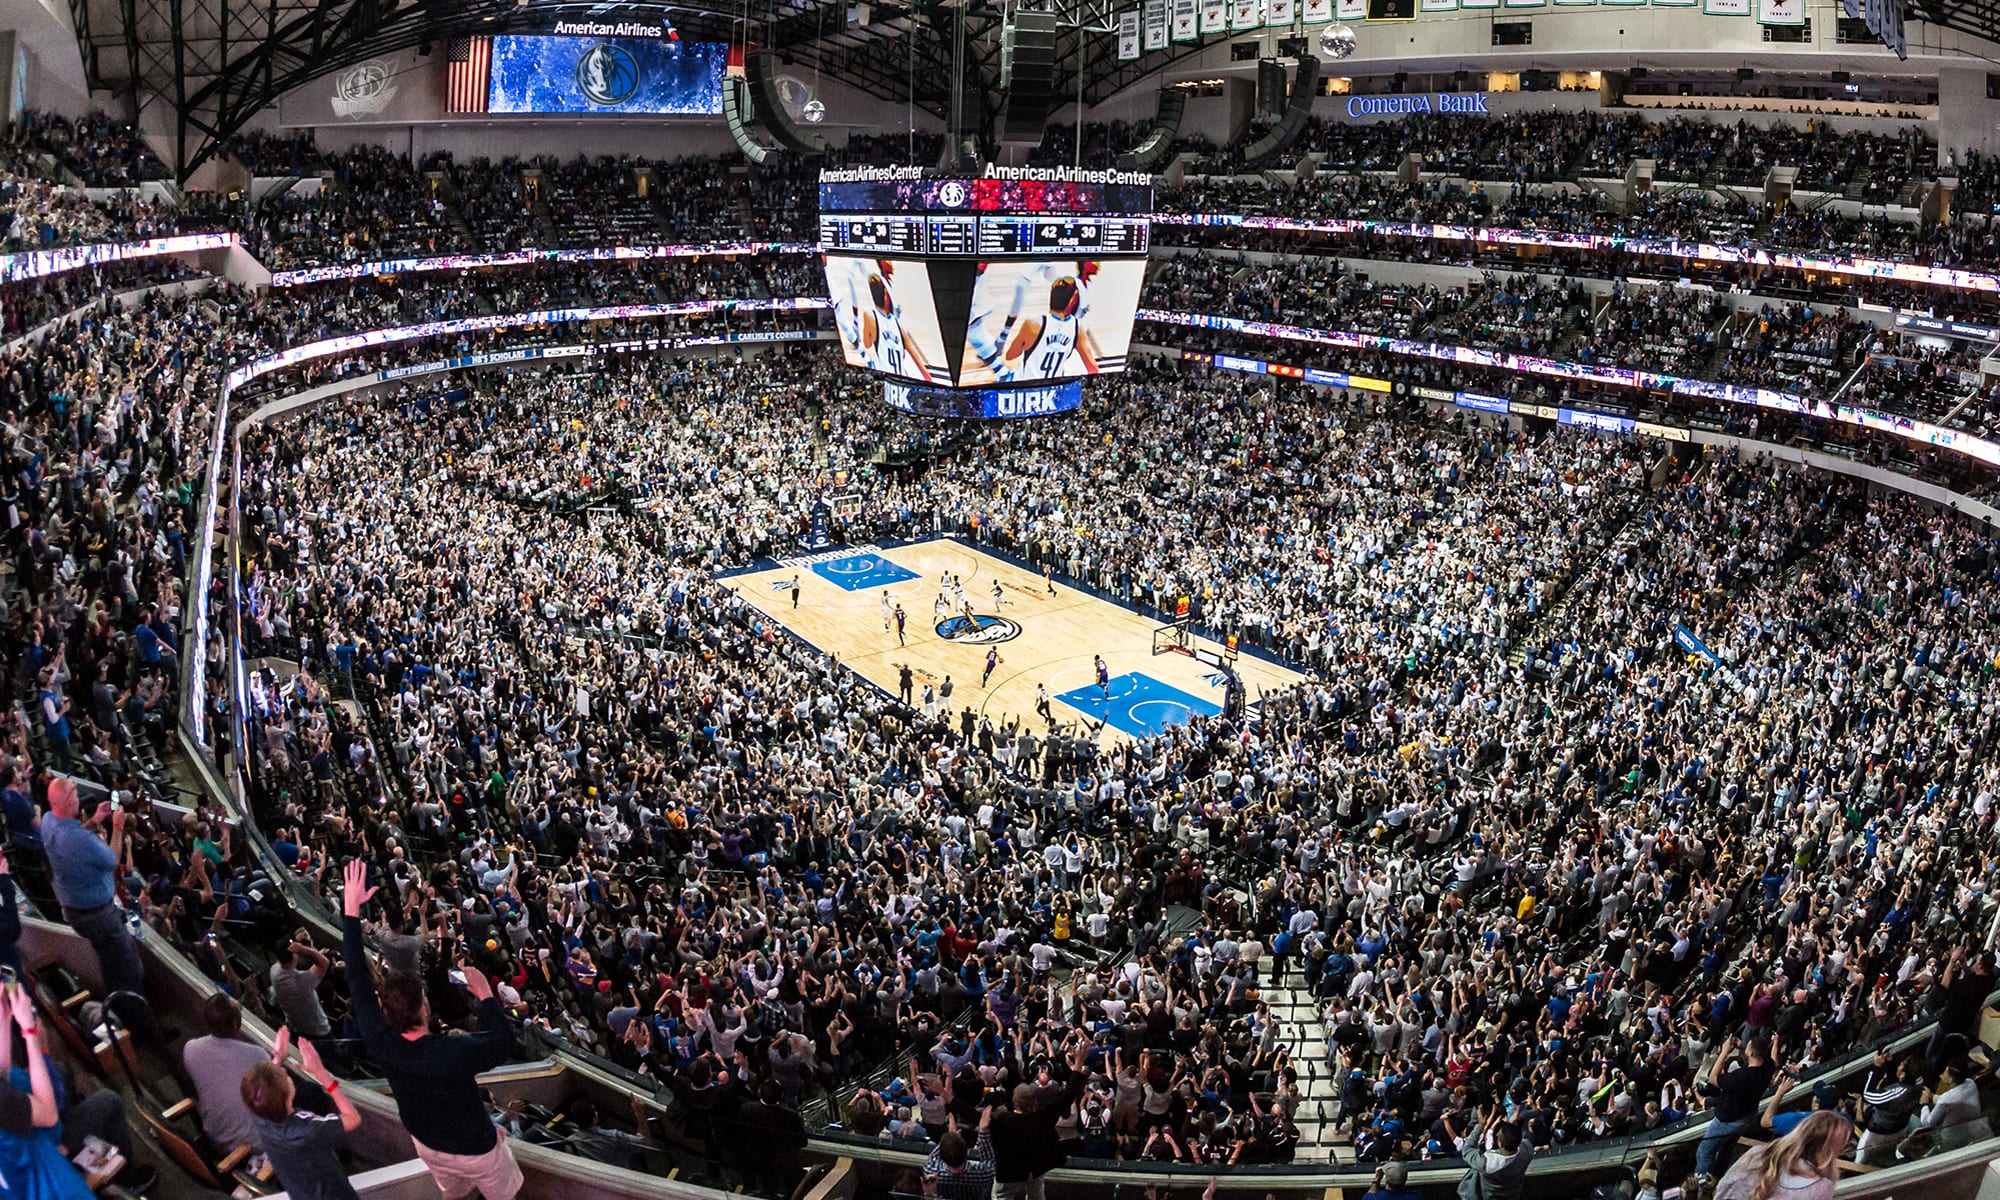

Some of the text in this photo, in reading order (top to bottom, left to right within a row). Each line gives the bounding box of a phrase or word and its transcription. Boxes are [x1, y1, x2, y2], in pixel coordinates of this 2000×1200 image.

[554, 21, 662, 37] American Airlines
[1438, 92, 1488, 113] Bank
[1041, 226, 1057, 238] 42
[1081, 226, 1096, 238] 30
[887, 347, 900, 375] 41
[1039, 351, 1065, 379] 41
[998, 391, 1057, 415] DIRK
